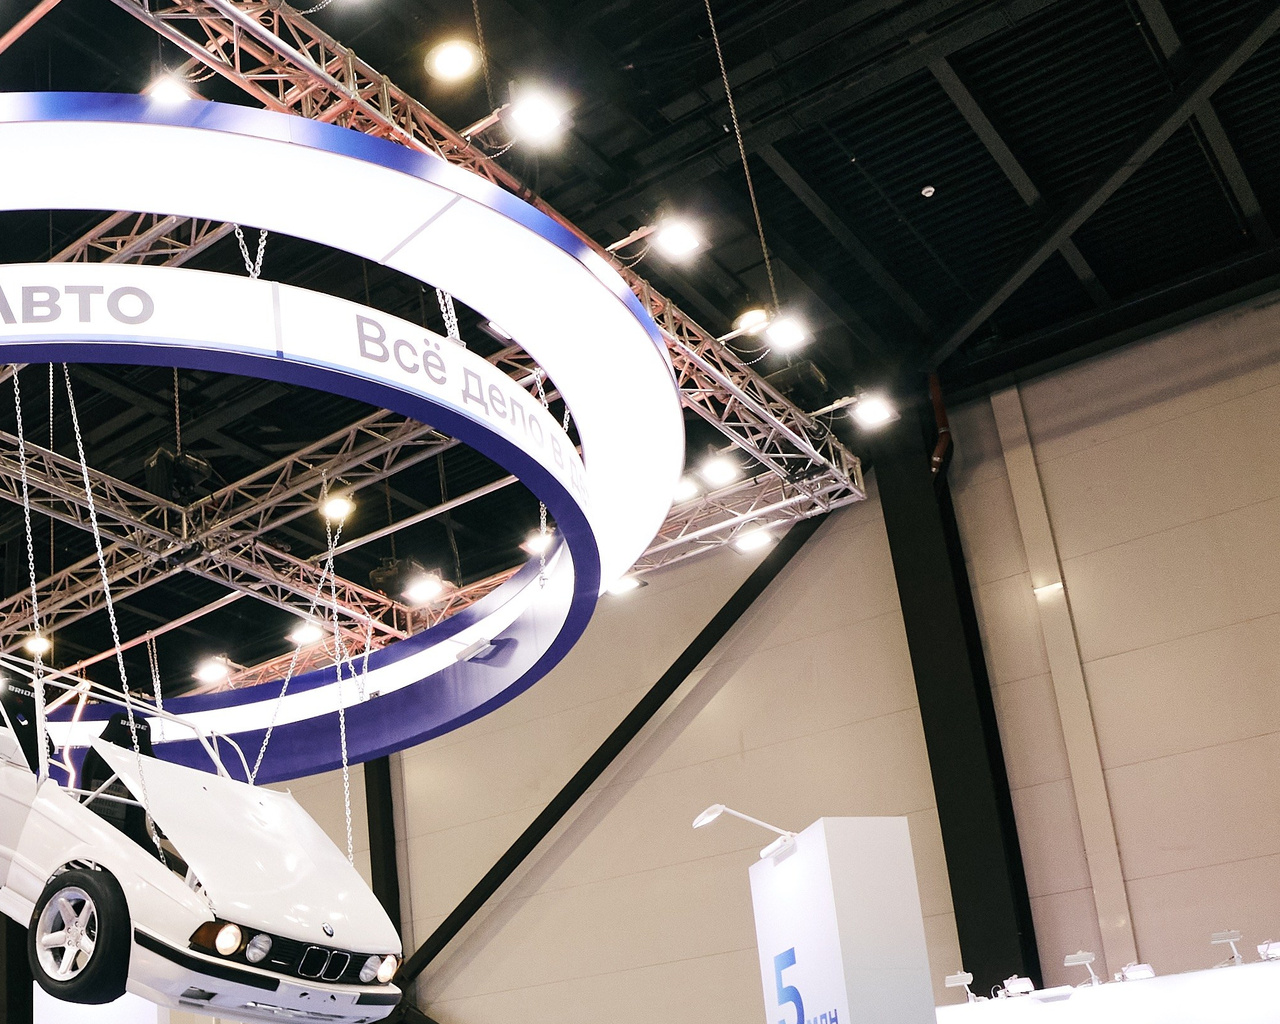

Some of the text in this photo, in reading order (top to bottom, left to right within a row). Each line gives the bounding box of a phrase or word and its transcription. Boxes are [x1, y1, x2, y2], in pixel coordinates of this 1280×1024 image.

[356, 314, 447, 386] Всё
[462, 366, 545, 449] дело
[550, 433, 564, 470] в
[120, 719, 149, 732] BRDE
